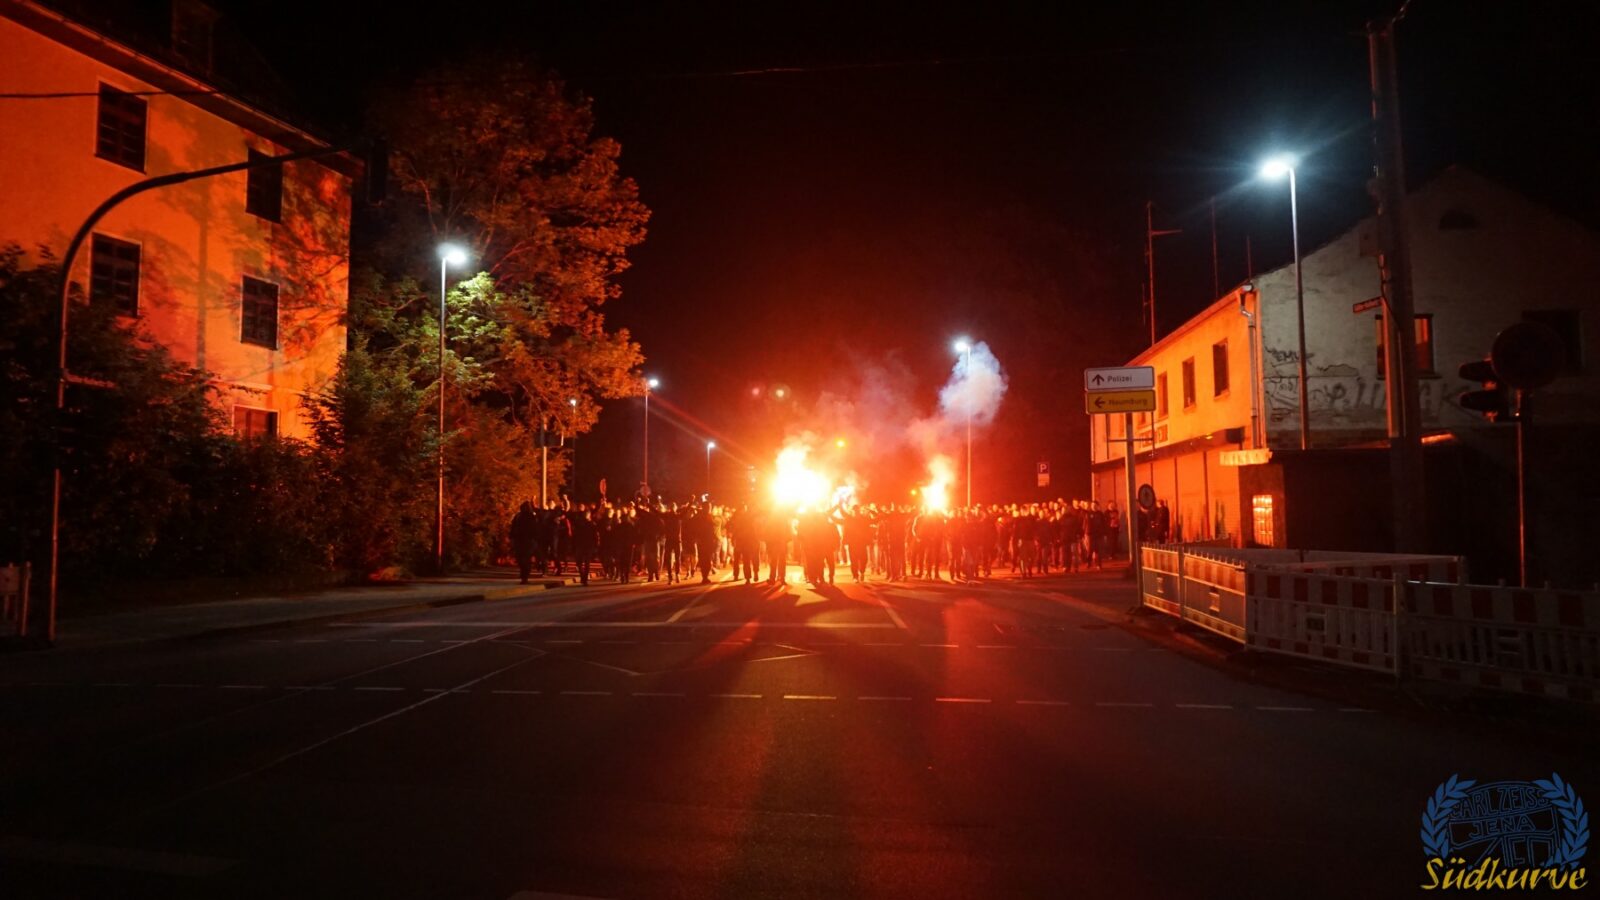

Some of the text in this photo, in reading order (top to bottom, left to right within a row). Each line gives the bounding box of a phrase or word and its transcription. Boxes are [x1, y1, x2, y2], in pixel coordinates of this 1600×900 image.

[1107, 375, 1133, 383] Polizei
[1108, 397, 1148, 407] Naumburg
[1039, 463, 1048, 473] P
